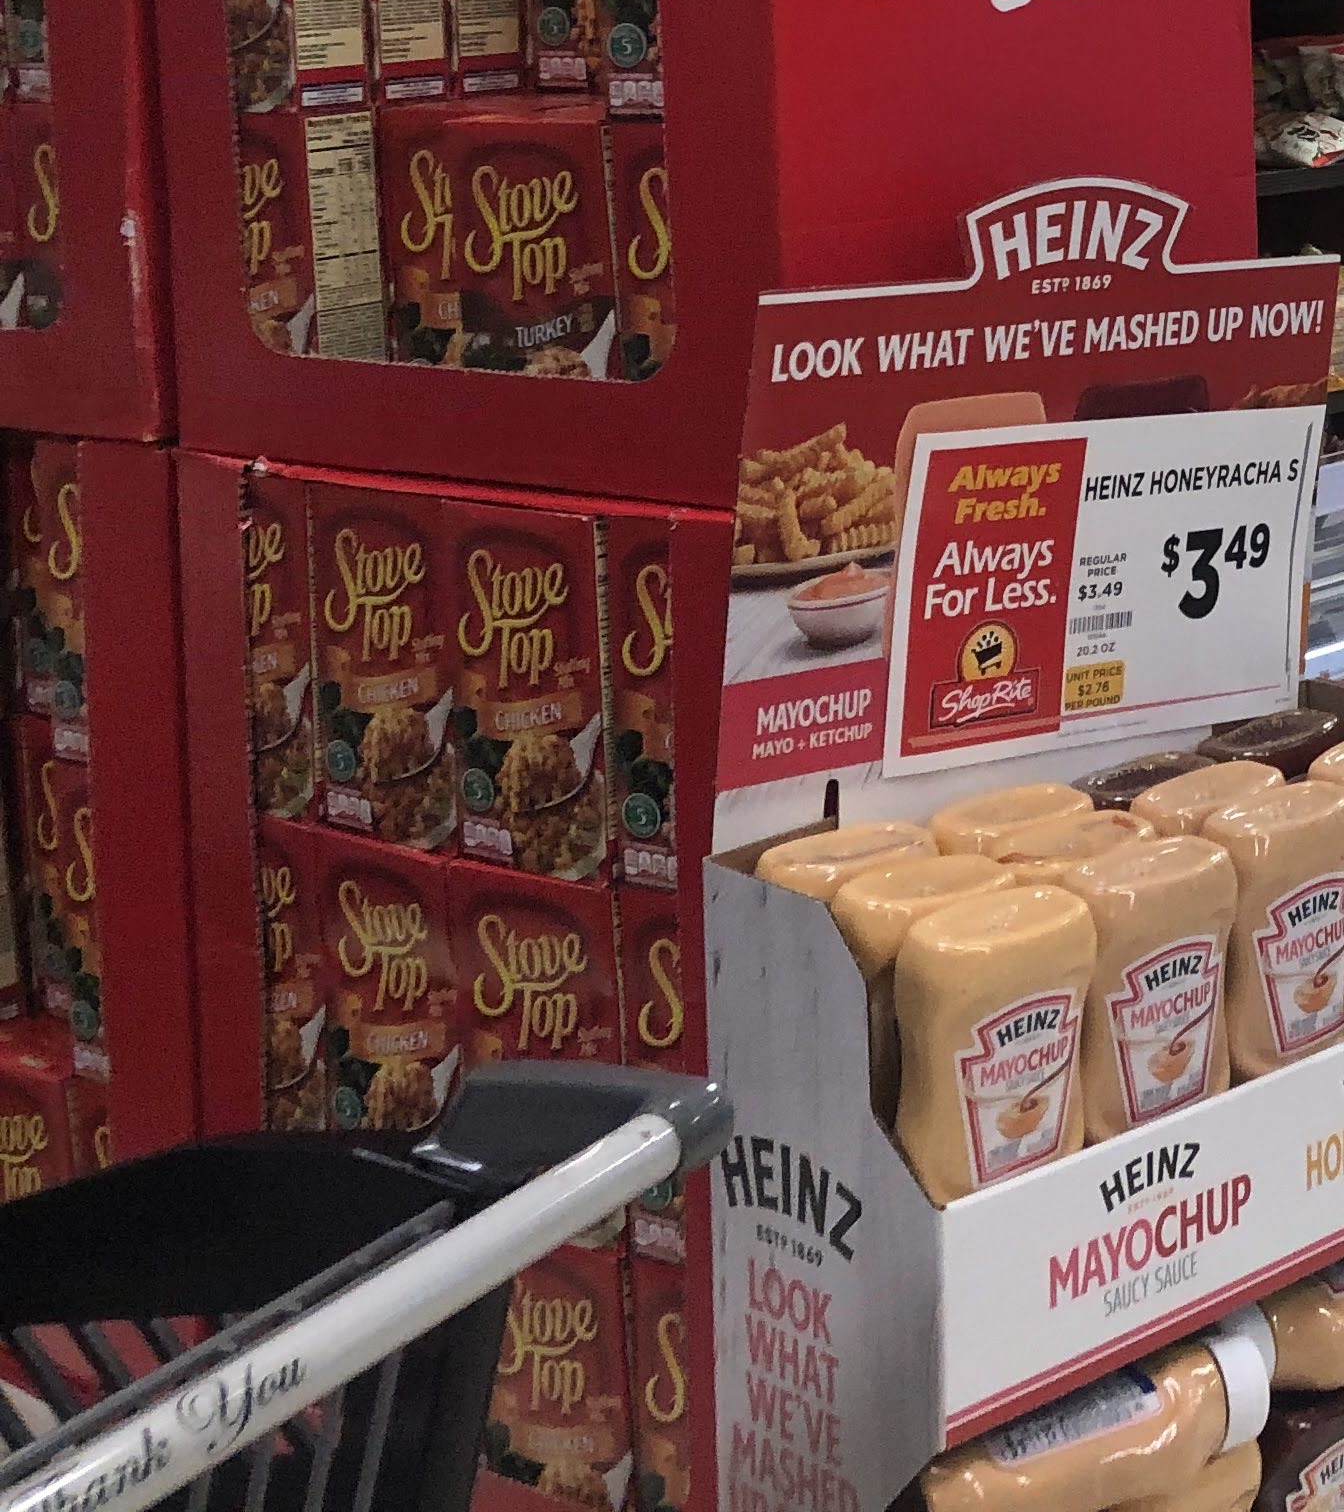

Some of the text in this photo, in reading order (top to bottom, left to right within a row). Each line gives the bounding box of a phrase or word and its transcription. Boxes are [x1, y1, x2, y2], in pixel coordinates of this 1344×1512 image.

[464, 165, 579, 273] Stove
[989, 200, 1164, 281] HEINZ
[505, 236, 567, 301] Top
[1074, 274, 1112, 292] 1869
[515, 313, 574, 348] TURKEY
[771, 300, 1324, 383] LOOK WHAT WE'VE MASHED UP NOW!
[948, 463, 1062, 493] Always
[1084, 458, 1299, 502] HEINZ HONEYRACHA S
[954, 492, 1047, 525] Fresh.
[325, 528, 427, 632] Stove
[933, 539, 1054, 580] Always
[1079, 552, 1127, 567] REGULAR
[1087, 565, 1117, 577] PRICE
[458, 549, 569, 656] Stove
[923, 576, 1057, 620] For Less.
[1077, 581, 1123, 602] $3.49
[360, 603, 412, 662] Top
[498, 626, 555, 688] Top
[1100, 642, 1116, 654] OZ
[1065, 666, 1123, 683] UNIT PRICE
[495, 702, 563, 731] CHICKEN
[757, 688, 871, 736] MAYOCHUP
[938, 678, 1032, 724] ShopRite
[1064, 694, 1121, 711] PER POUND
[752, 722, 873, 760] MAYO KETCHUP
[338, 880, 428, 977] Stove
[1288, 890, 1339, 927] HEINZ
[374, 953, 428, 1013] Top
[474, 915, 588, 1017] Stove
[1144, 953, 1203, 992] HEINZ
[518, 990, 578, 1051] Top
[996, 1008, 1061, 1048] HEINZ
[1130, 981, 1211, 1030] MAYOCHUP
[980, 1036, 1069, 1087] MAYOCHUP
[720, 1135, 863, 1263] HEINZ
[1099, 1142, 1200, 1213] HEINZ
[791, 1239, 823, 1267] 1869
[1049, 1173, 1253, 1309] MAYOCHUP
[746, 1256, 832, 1344] LOOK
[1103, 1251, 1198, 1317] SAUCY SAUCE
[746, 1314, 839, 1404] WHAT
[176, 1355, 304, 1451] You
[530, 1356, 585, 1415] Top
[746, 1371, 841, 1468] WE'VE
